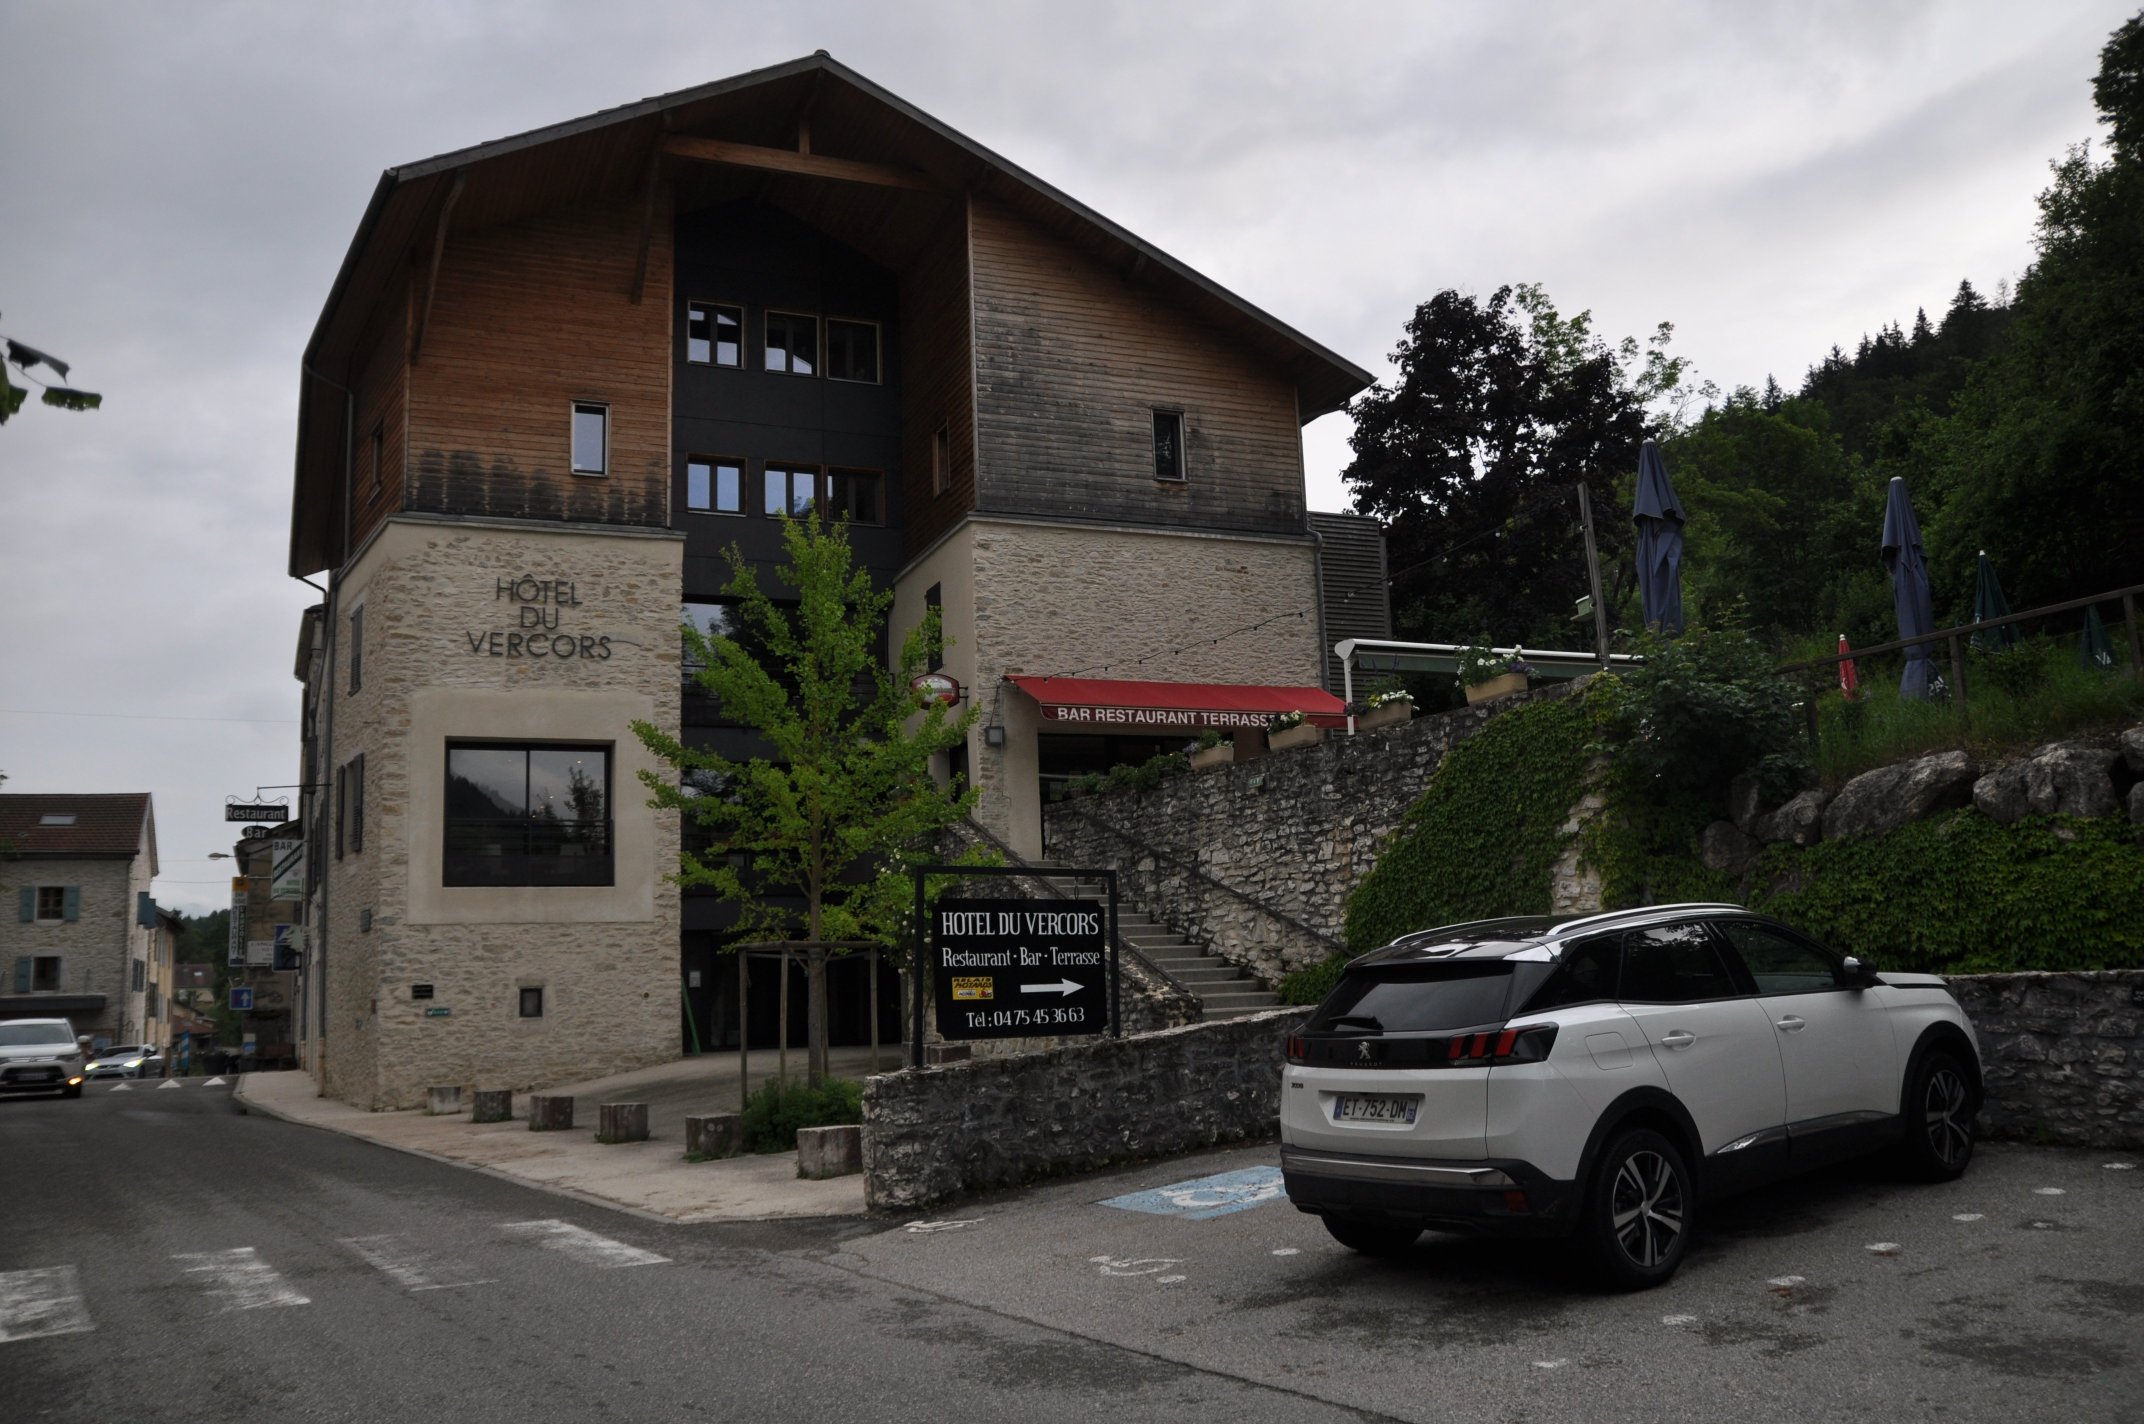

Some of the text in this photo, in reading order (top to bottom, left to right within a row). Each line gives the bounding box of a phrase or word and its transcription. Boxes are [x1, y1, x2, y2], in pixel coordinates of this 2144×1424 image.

[496, 574, 583, 605] HÔTEL
[520, 606, 559, 630] DU
[466, 631, 611, 659] VERCORS
[1057, 707, 1091, 721] BAR
[1095, 708, 1198, 725] RESTAURANT
[226, 807, 286, 820] Restaurant
[245, 828, 267, 839] Bar
[273, 841, 293, 850] BAR
[941, 912, 1099, 936] HOTEL DU VERCORS
[942, 946, 1100, 967] Restaurant Bar Terrasse
[993, 1011, 1012, 1026] 04
[1013, 1009, 1030, 1025] 75
[1032, 1008, 1049, 1024] 45
[1051, 1008, 1067, 1023] 36
[1068, 1007, 1085, 1022] 63
